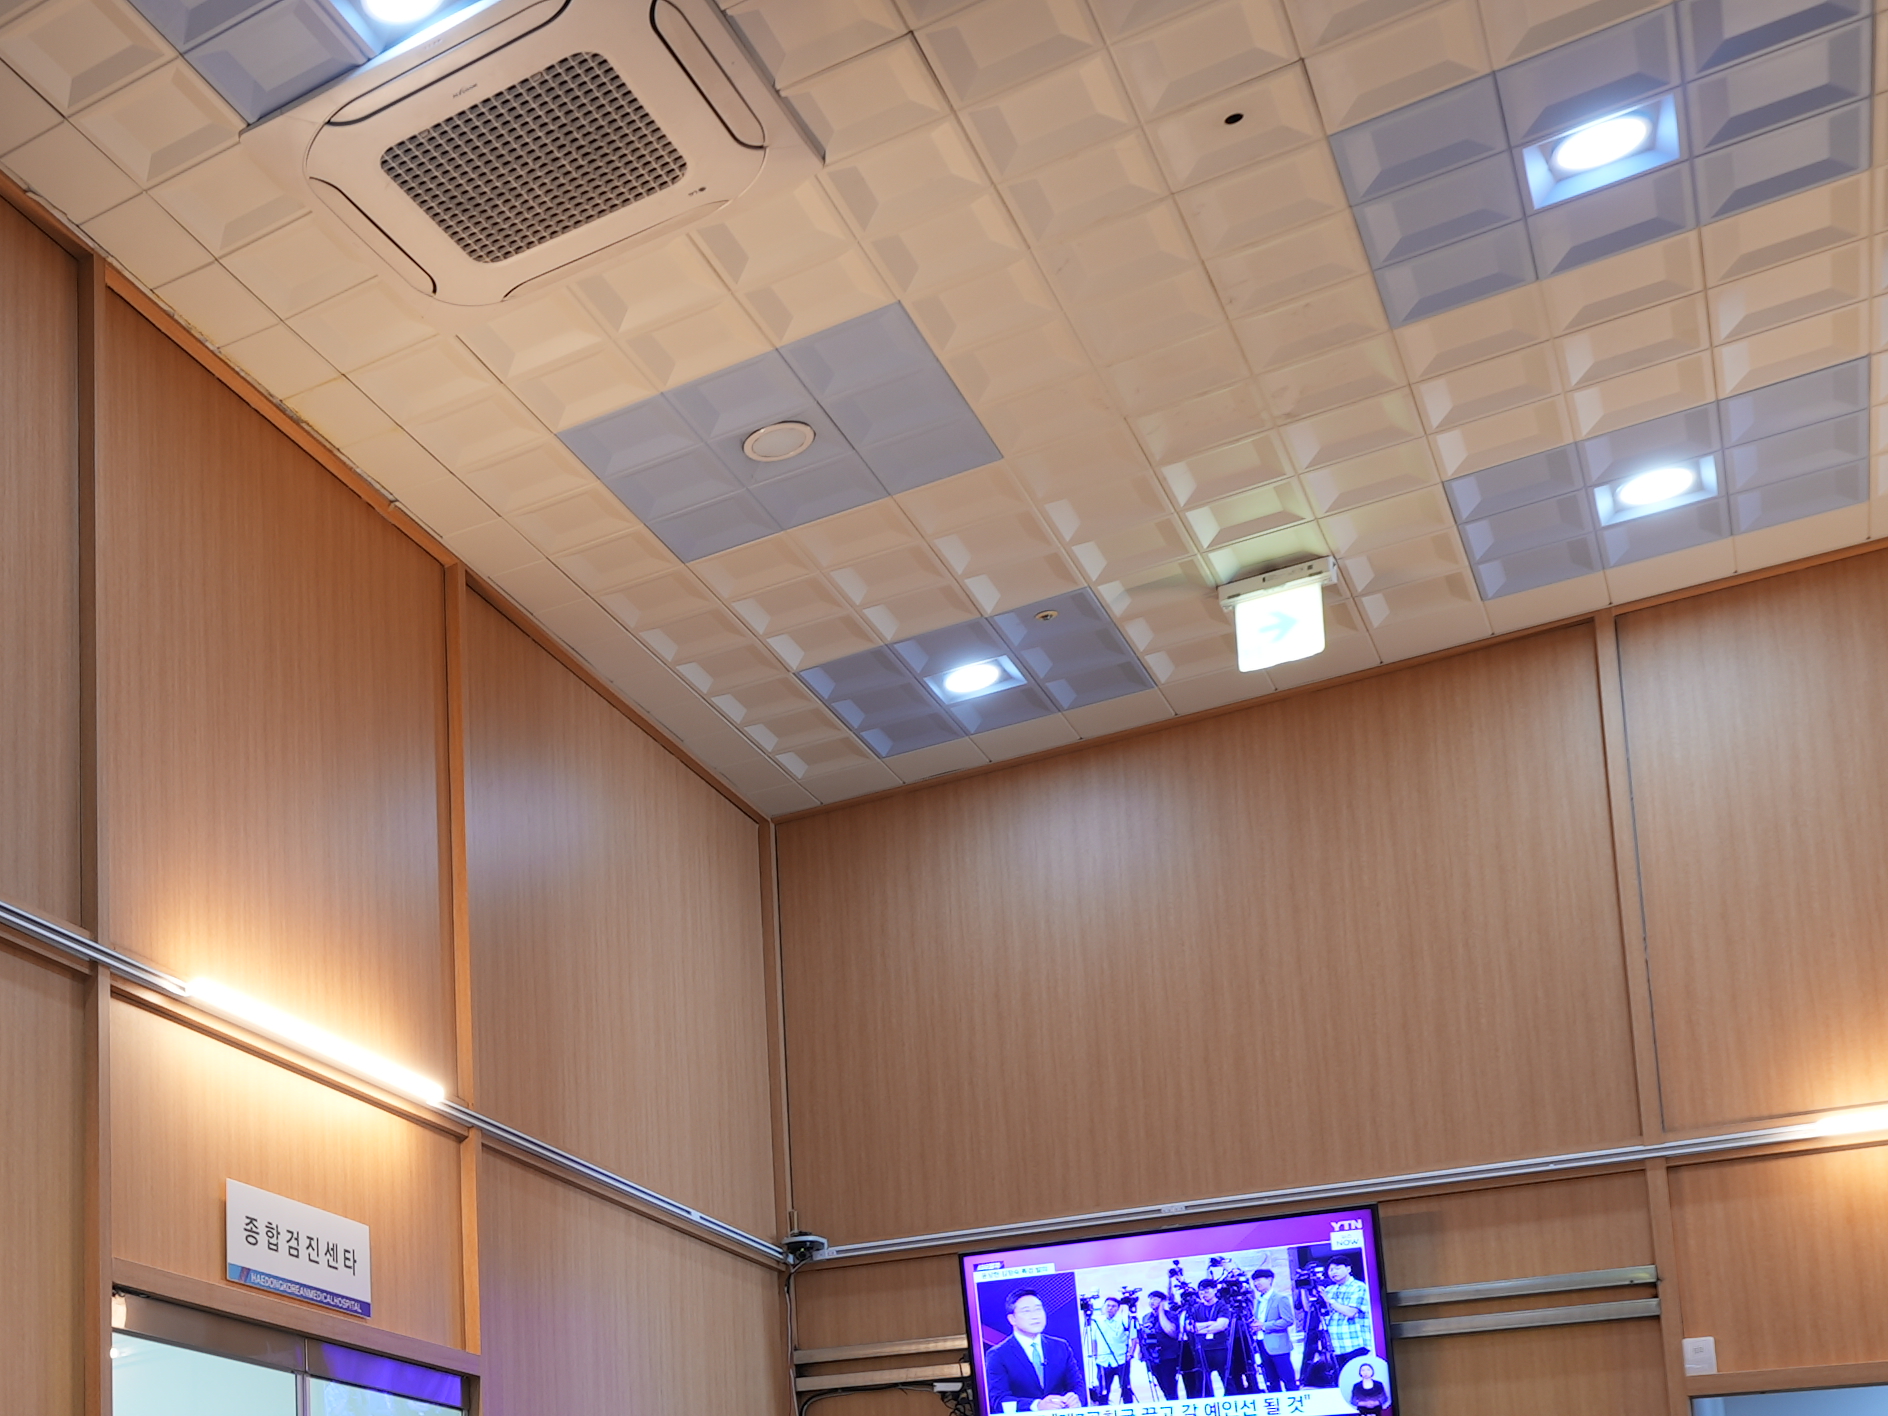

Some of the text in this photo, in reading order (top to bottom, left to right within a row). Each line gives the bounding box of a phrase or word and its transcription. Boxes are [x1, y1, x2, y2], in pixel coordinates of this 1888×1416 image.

[1330, 1219, 1362, 1231] YTN
[243, 1215, 357, 1277] 종합검진센타
[1264, 1396, 1280, 1415] 될
